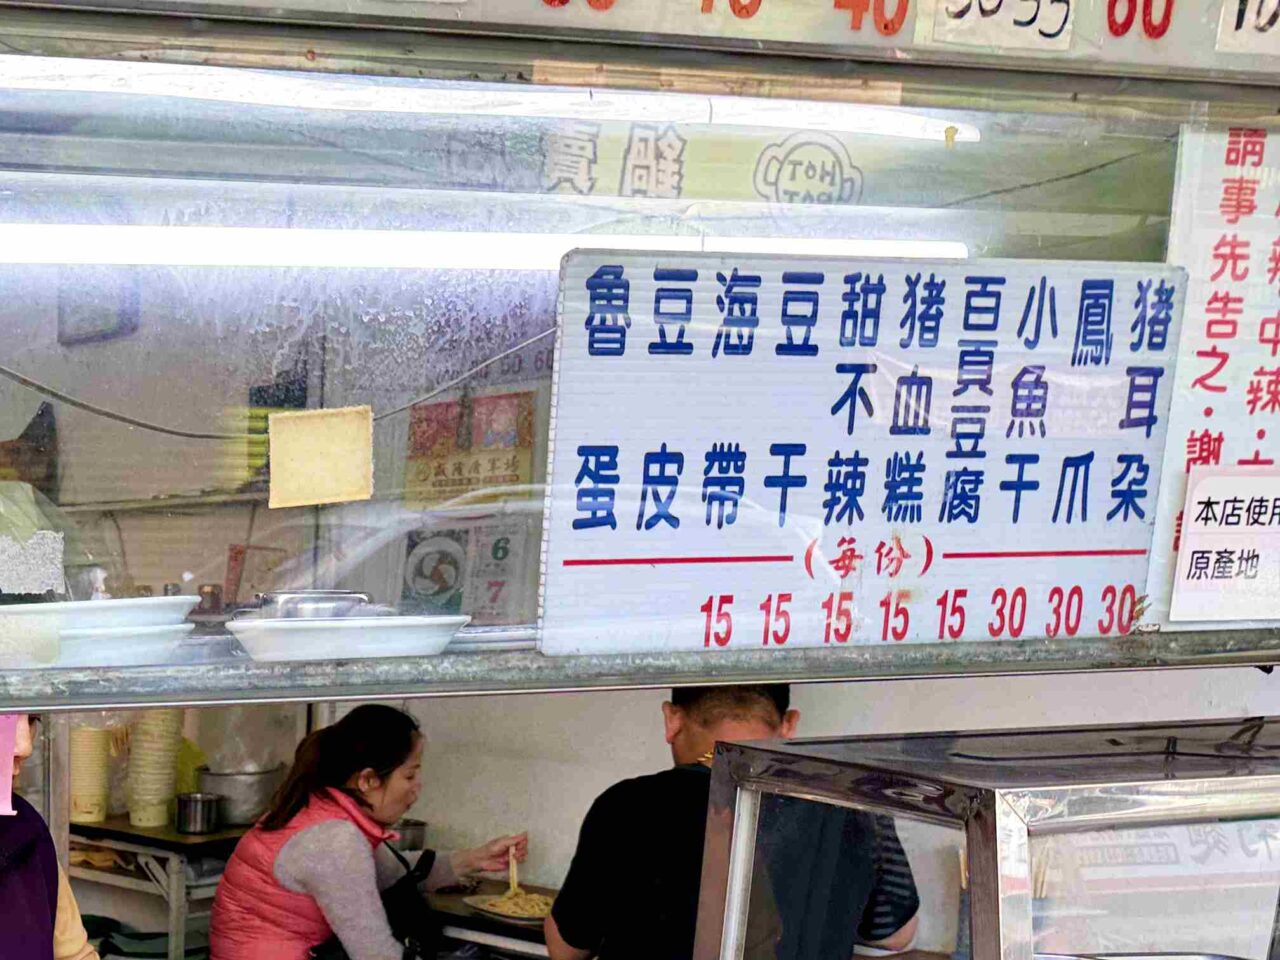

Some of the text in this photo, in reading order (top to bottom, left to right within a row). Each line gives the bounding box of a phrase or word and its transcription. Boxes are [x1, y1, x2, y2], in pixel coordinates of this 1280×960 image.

[636, 268, 698, 530] 豆皮
[702, 267, 761, 529] 海帶
[823, 272, 886, 526] 甜不辣
[938, 276, 1006, 523] 百頁豆腐
[491, 537, 511, 561] 6
[700, 583, 1137, 648] 15 15 15 15 15 30 30 30
[1186, 549, 1260, 580] 原產地
